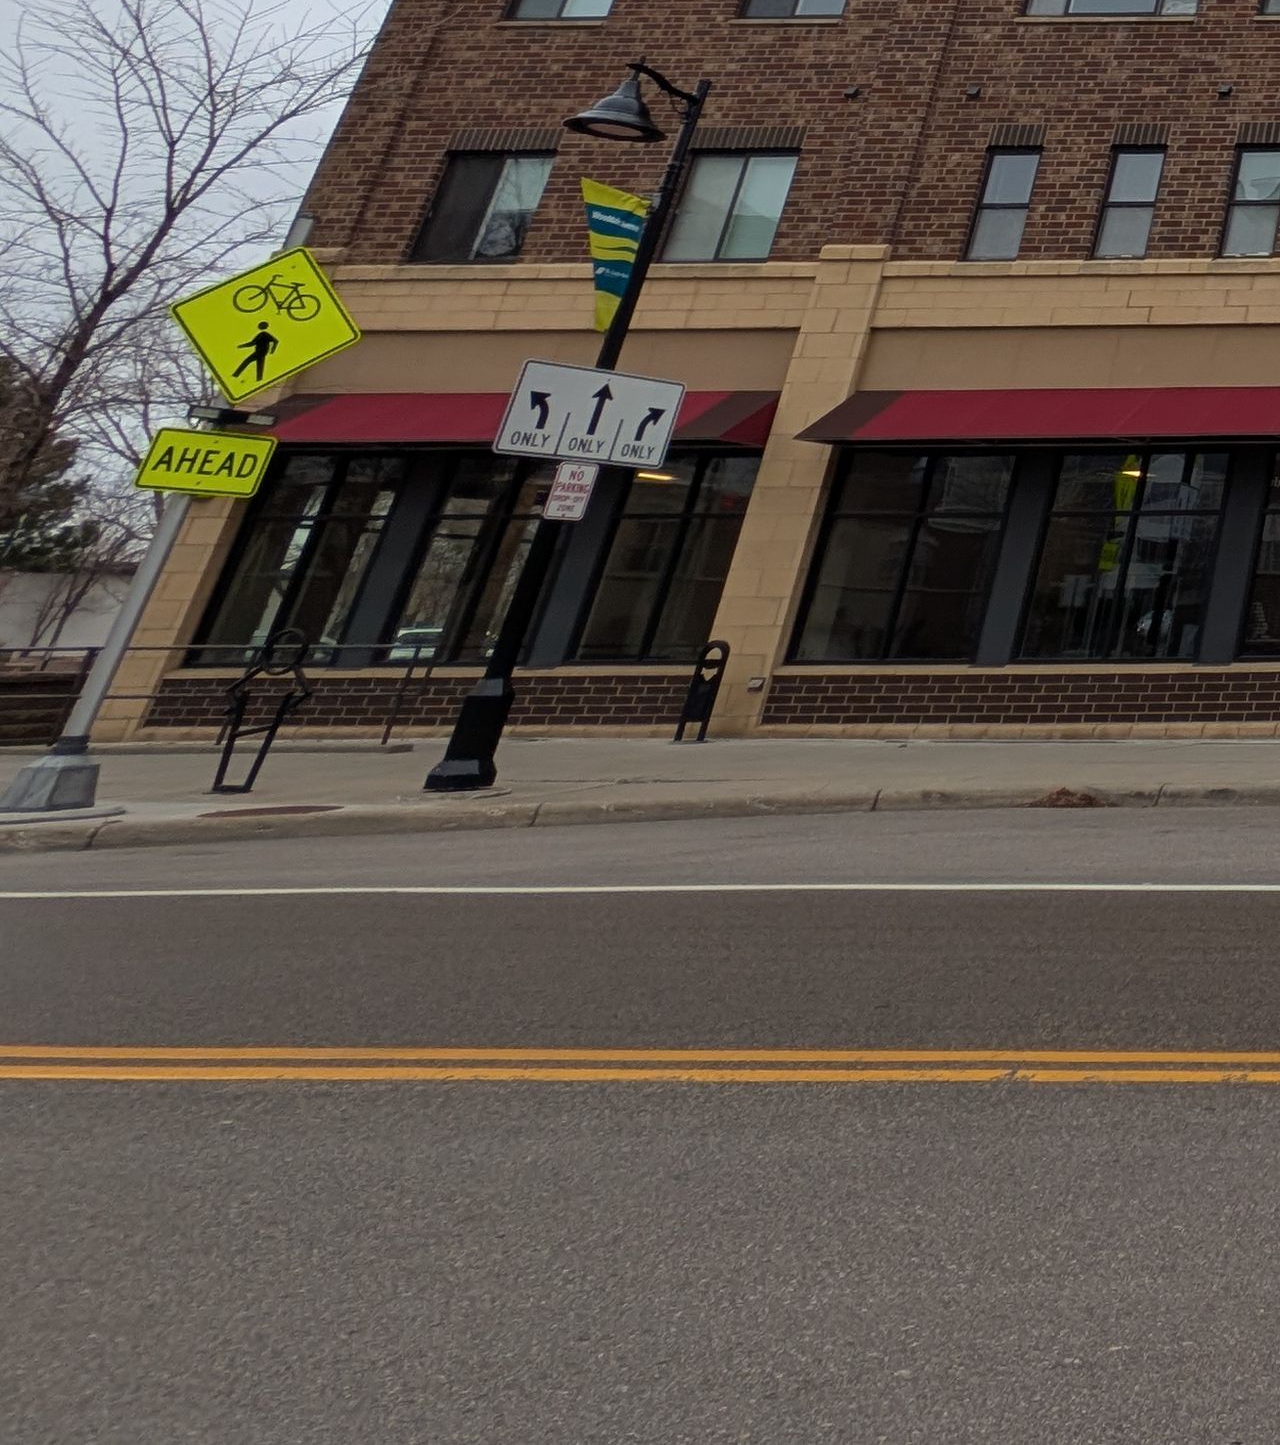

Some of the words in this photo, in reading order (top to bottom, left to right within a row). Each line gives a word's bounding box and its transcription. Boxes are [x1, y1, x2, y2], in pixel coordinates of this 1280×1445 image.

[510, 430, 551, 448] ONLY
[568, 437, 606, 454] ONLY
[621, 443, 655, 460] ONLY
[151, 445, 259, 478] AHEAD
[568, 470, 585, 482] NO
[554, 481, 591, 494] PARKING
